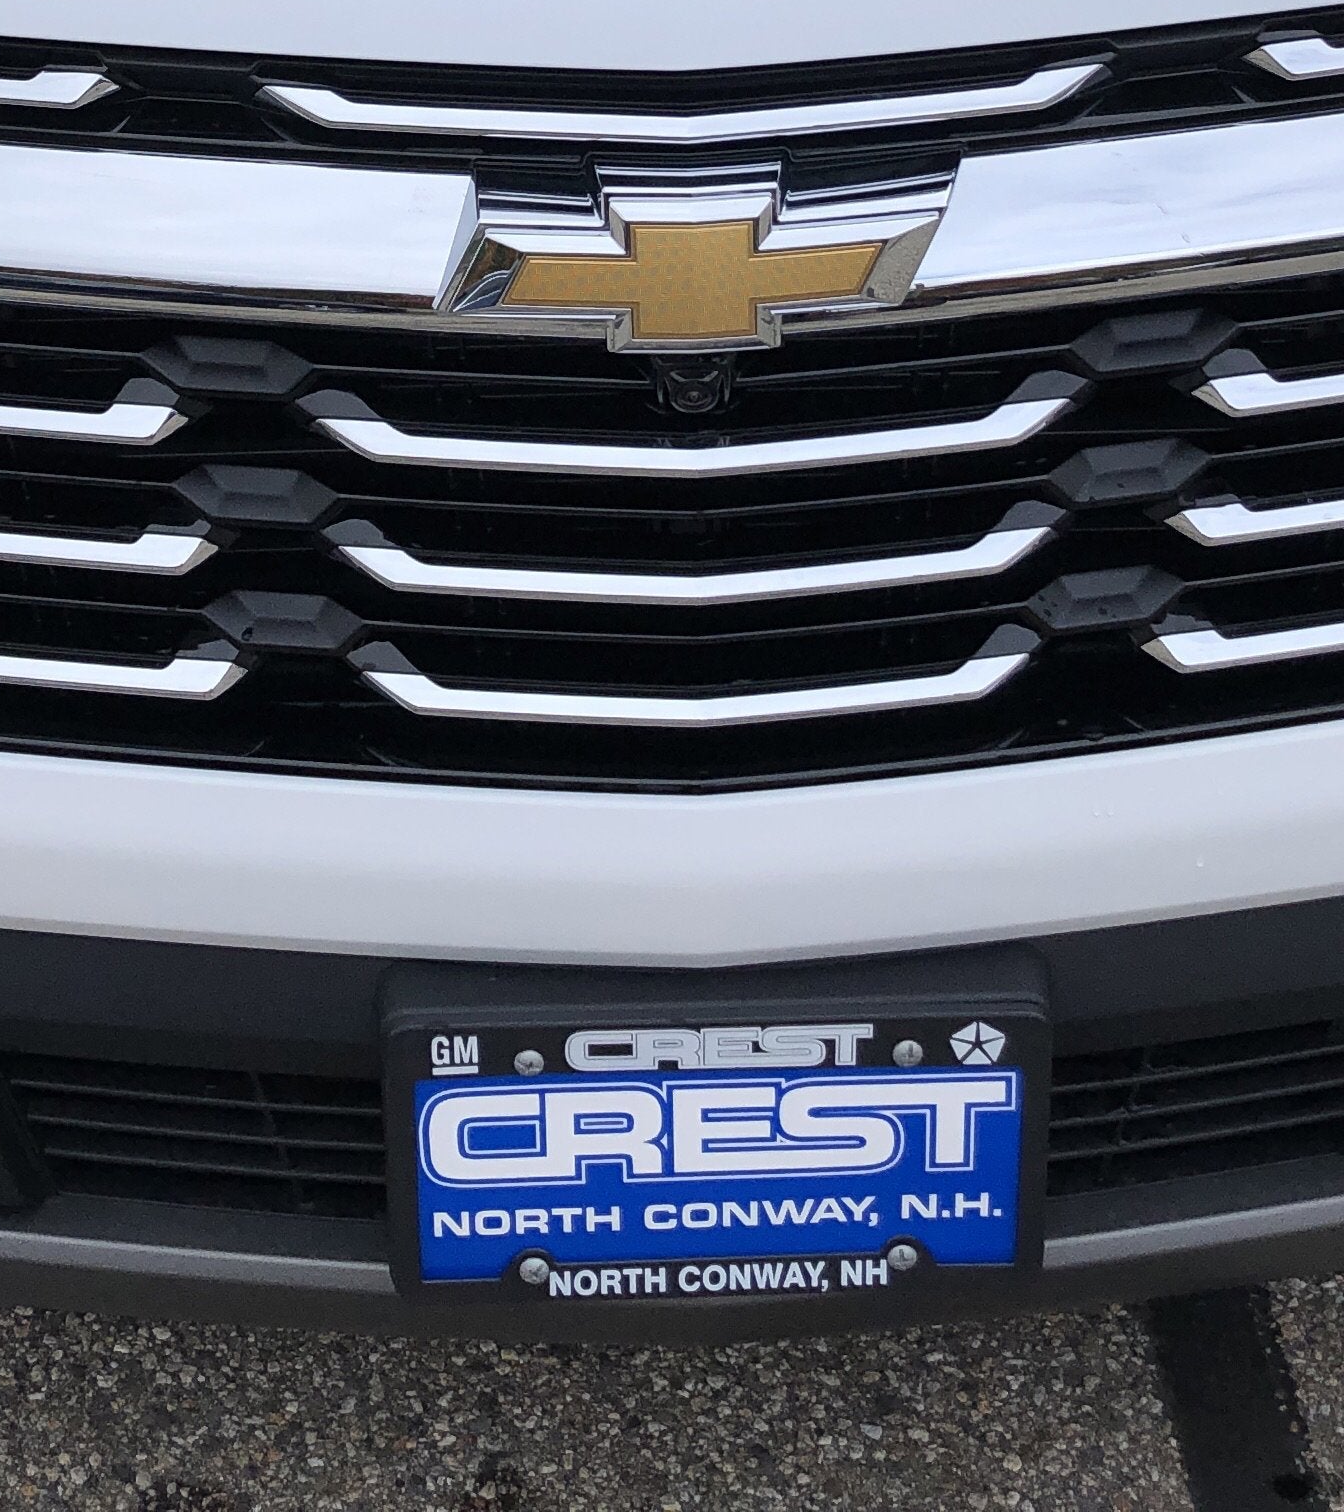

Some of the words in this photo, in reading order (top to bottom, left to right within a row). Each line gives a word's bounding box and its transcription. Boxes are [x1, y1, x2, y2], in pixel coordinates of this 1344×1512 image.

[430, 1035, 479, 1066] GM
[565, 1024, 874, 1072] CREST
[418, 1071, 1016, 1188] CREST
[433, 1206, 622, 1238] NORTH
[644, 1195, 879, 1231] CONWAY,
[900, 1191, 1002, 1220] N.H.
[548, 1267, 667, 1297] NORTH
[678, 1261, 829, 1293] CONWAY,
[840, 1259, 888, 1287] NH
